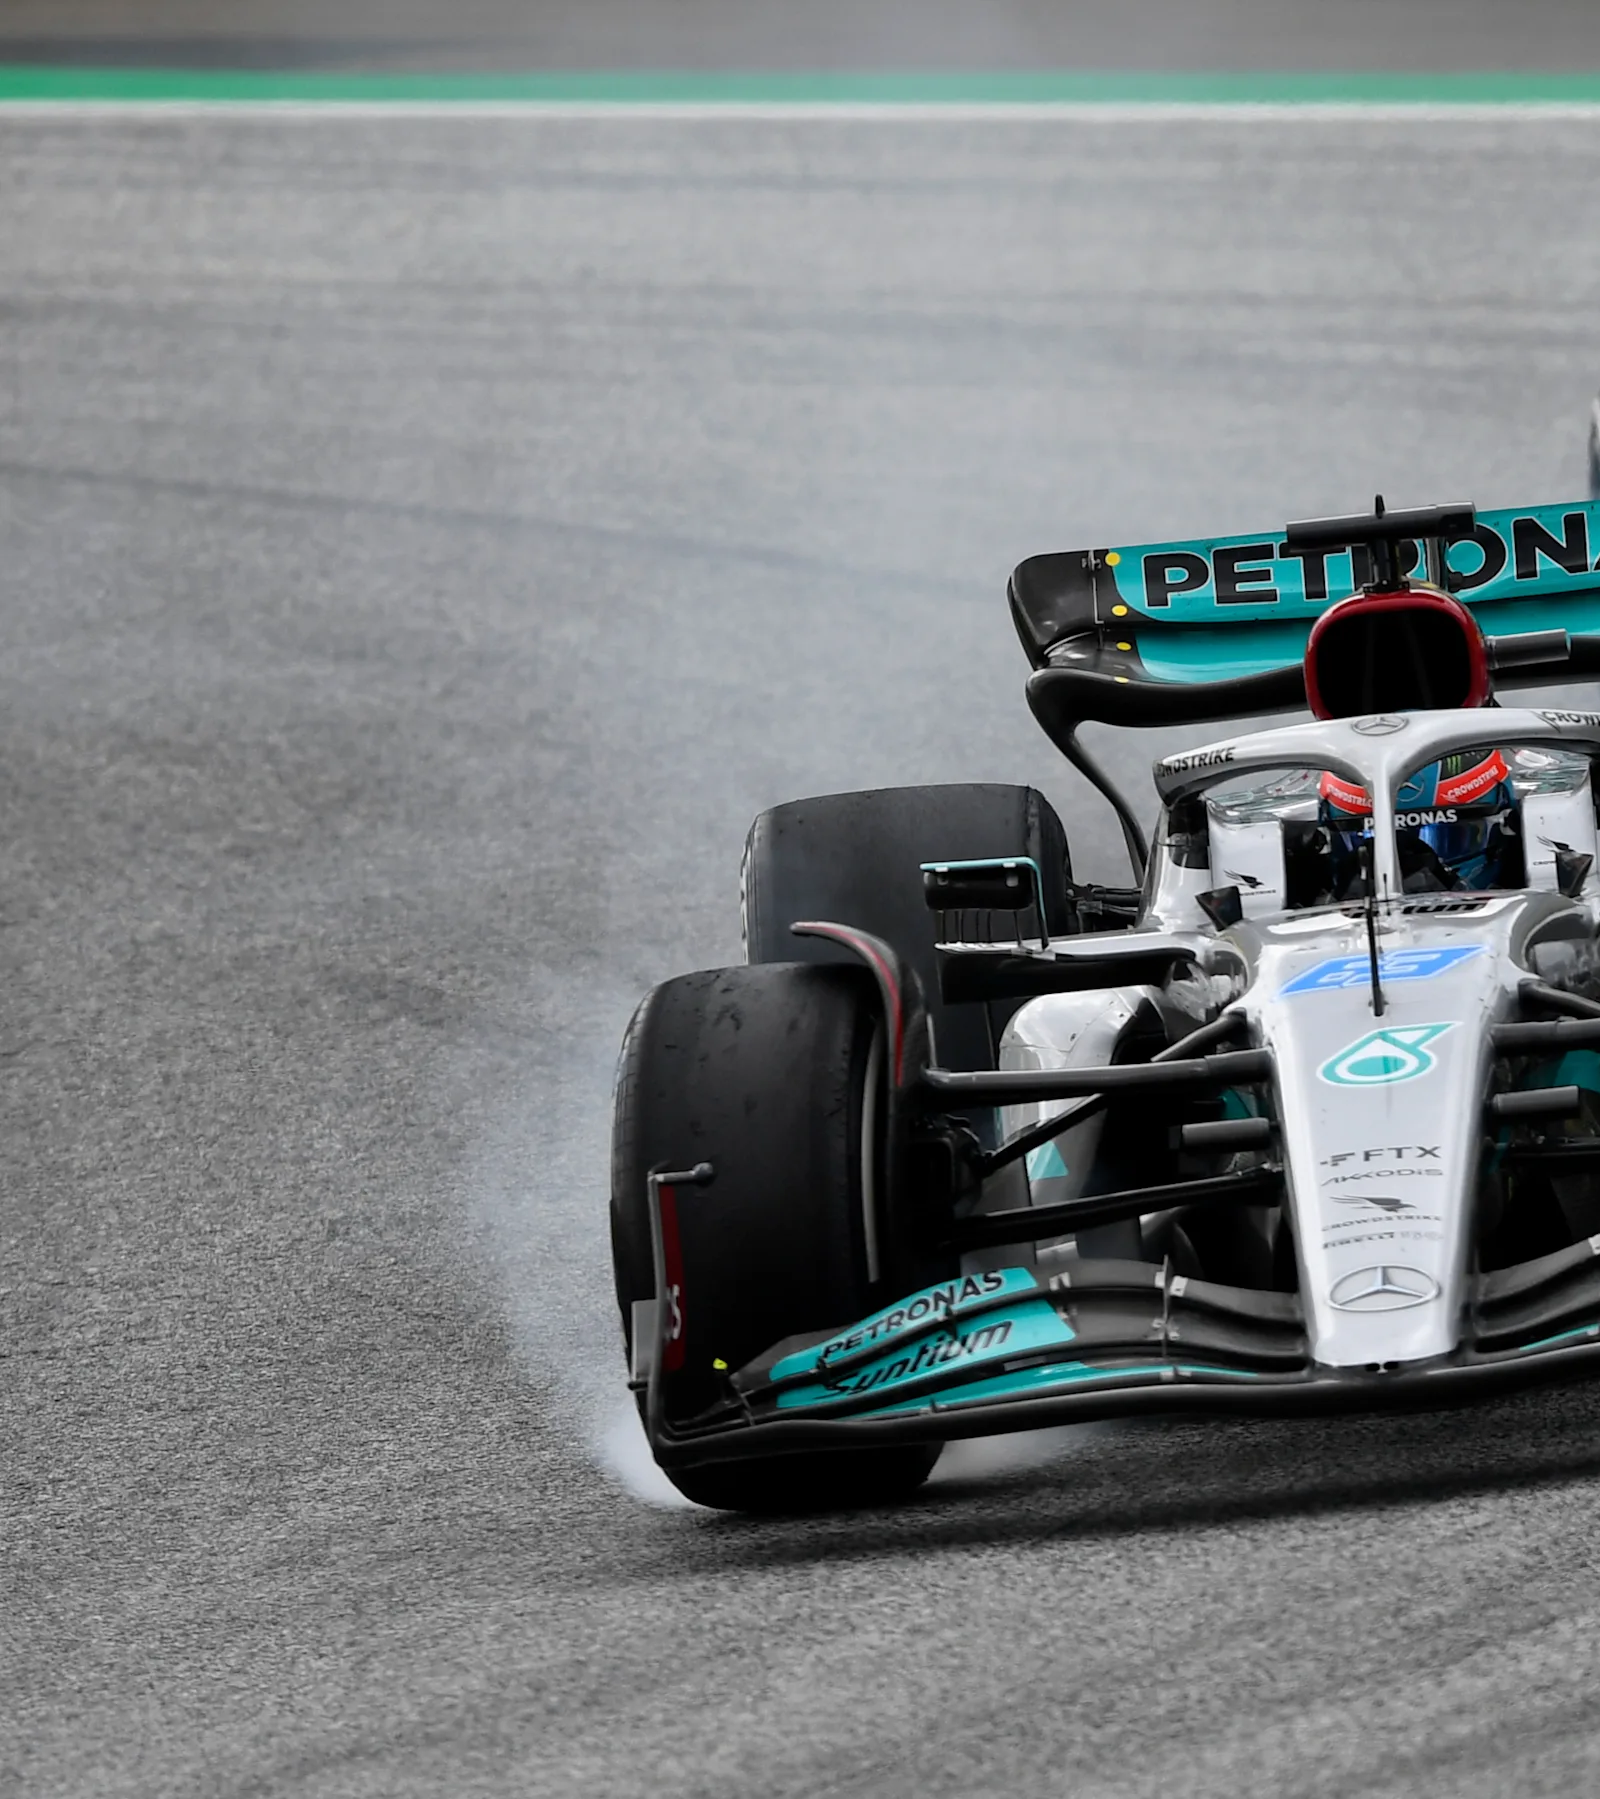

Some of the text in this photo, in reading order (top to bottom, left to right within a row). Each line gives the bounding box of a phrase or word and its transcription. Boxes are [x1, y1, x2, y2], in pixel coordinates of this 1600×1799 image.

[1447, 766, 1500, 799] CROWDSTRIKE
[1363, 809, 1458, 830] PRONAS
[1363, 1145, 1442, 1162] FTX
[1321, 1214, 1443, 1232] CROWDSTRIKE
[821, 1268, 1005, 1358] PETRONAS
[811, 1320, 1014, 1401] Syntium
